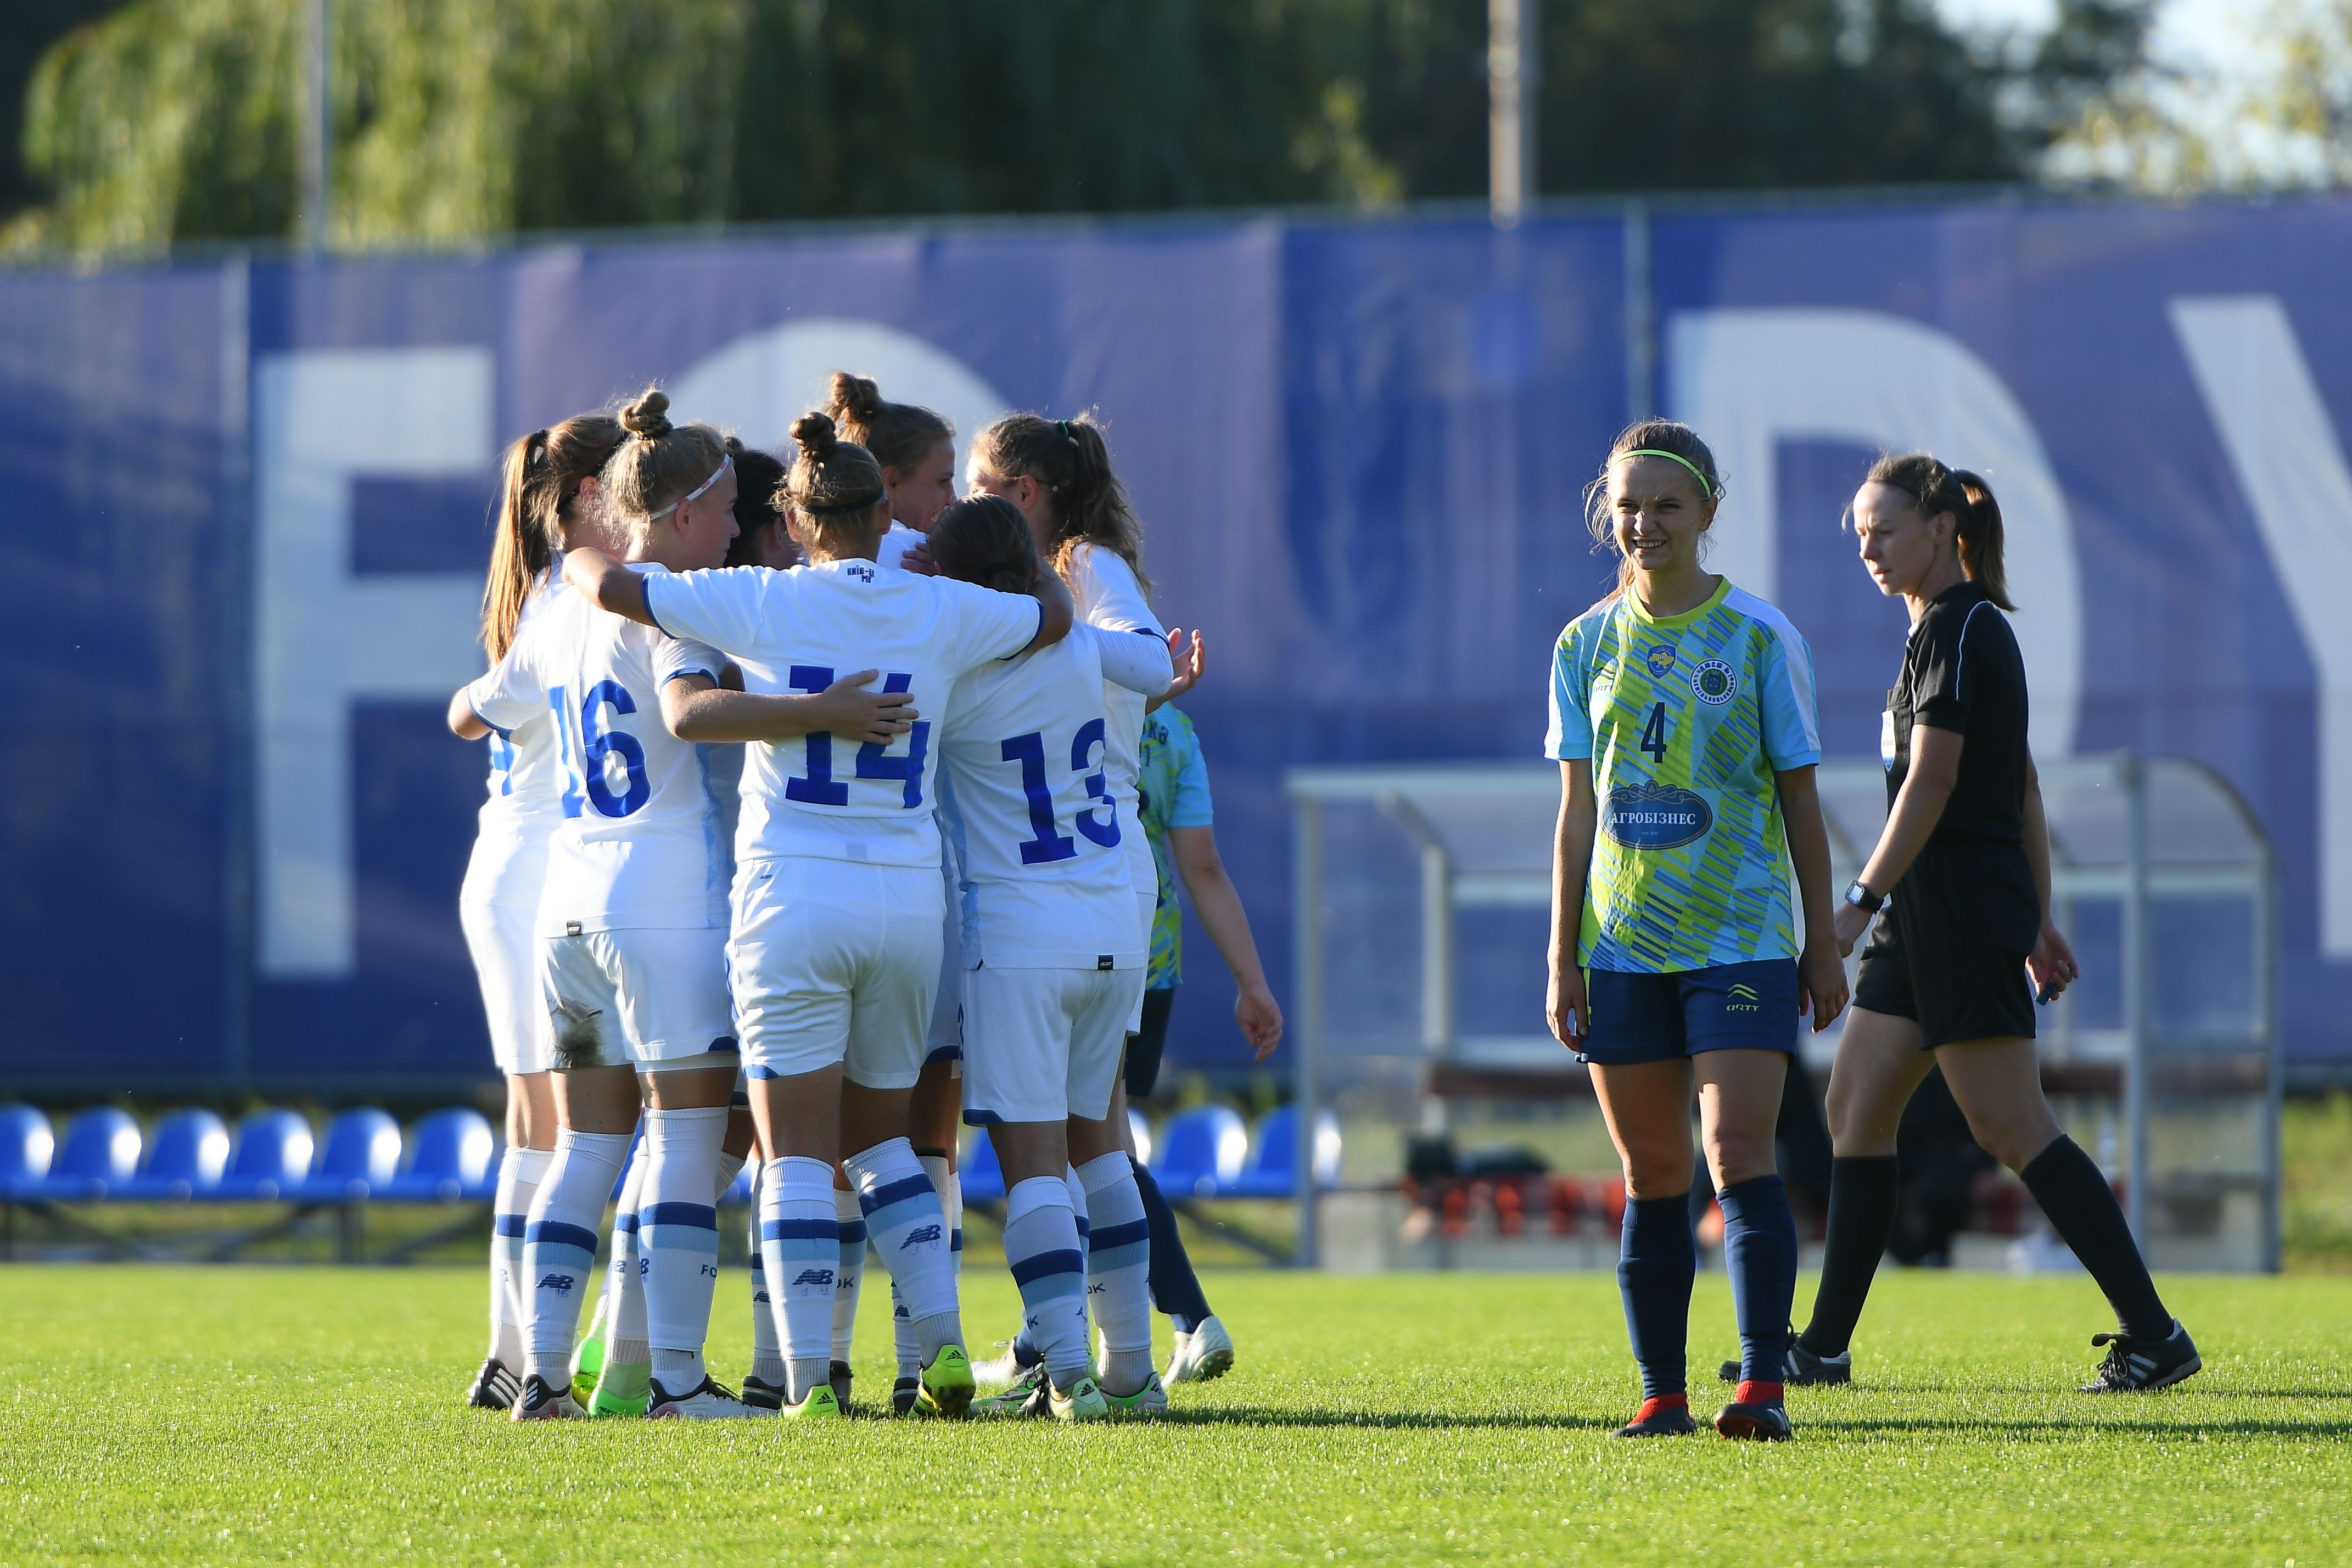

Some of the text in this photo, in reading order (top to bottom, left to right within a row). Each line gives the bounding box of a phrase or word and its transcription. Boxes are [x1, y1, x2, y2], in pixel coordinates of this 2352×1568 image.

[549, 680, 651, 818] 16
[785, 665, 931, 809] 14
[1001, 717, 1122, 865] 13
[1640, 702, 1667, 764] 4
[1610, 812, 1696, 825] АГРОБІЗНЕС
